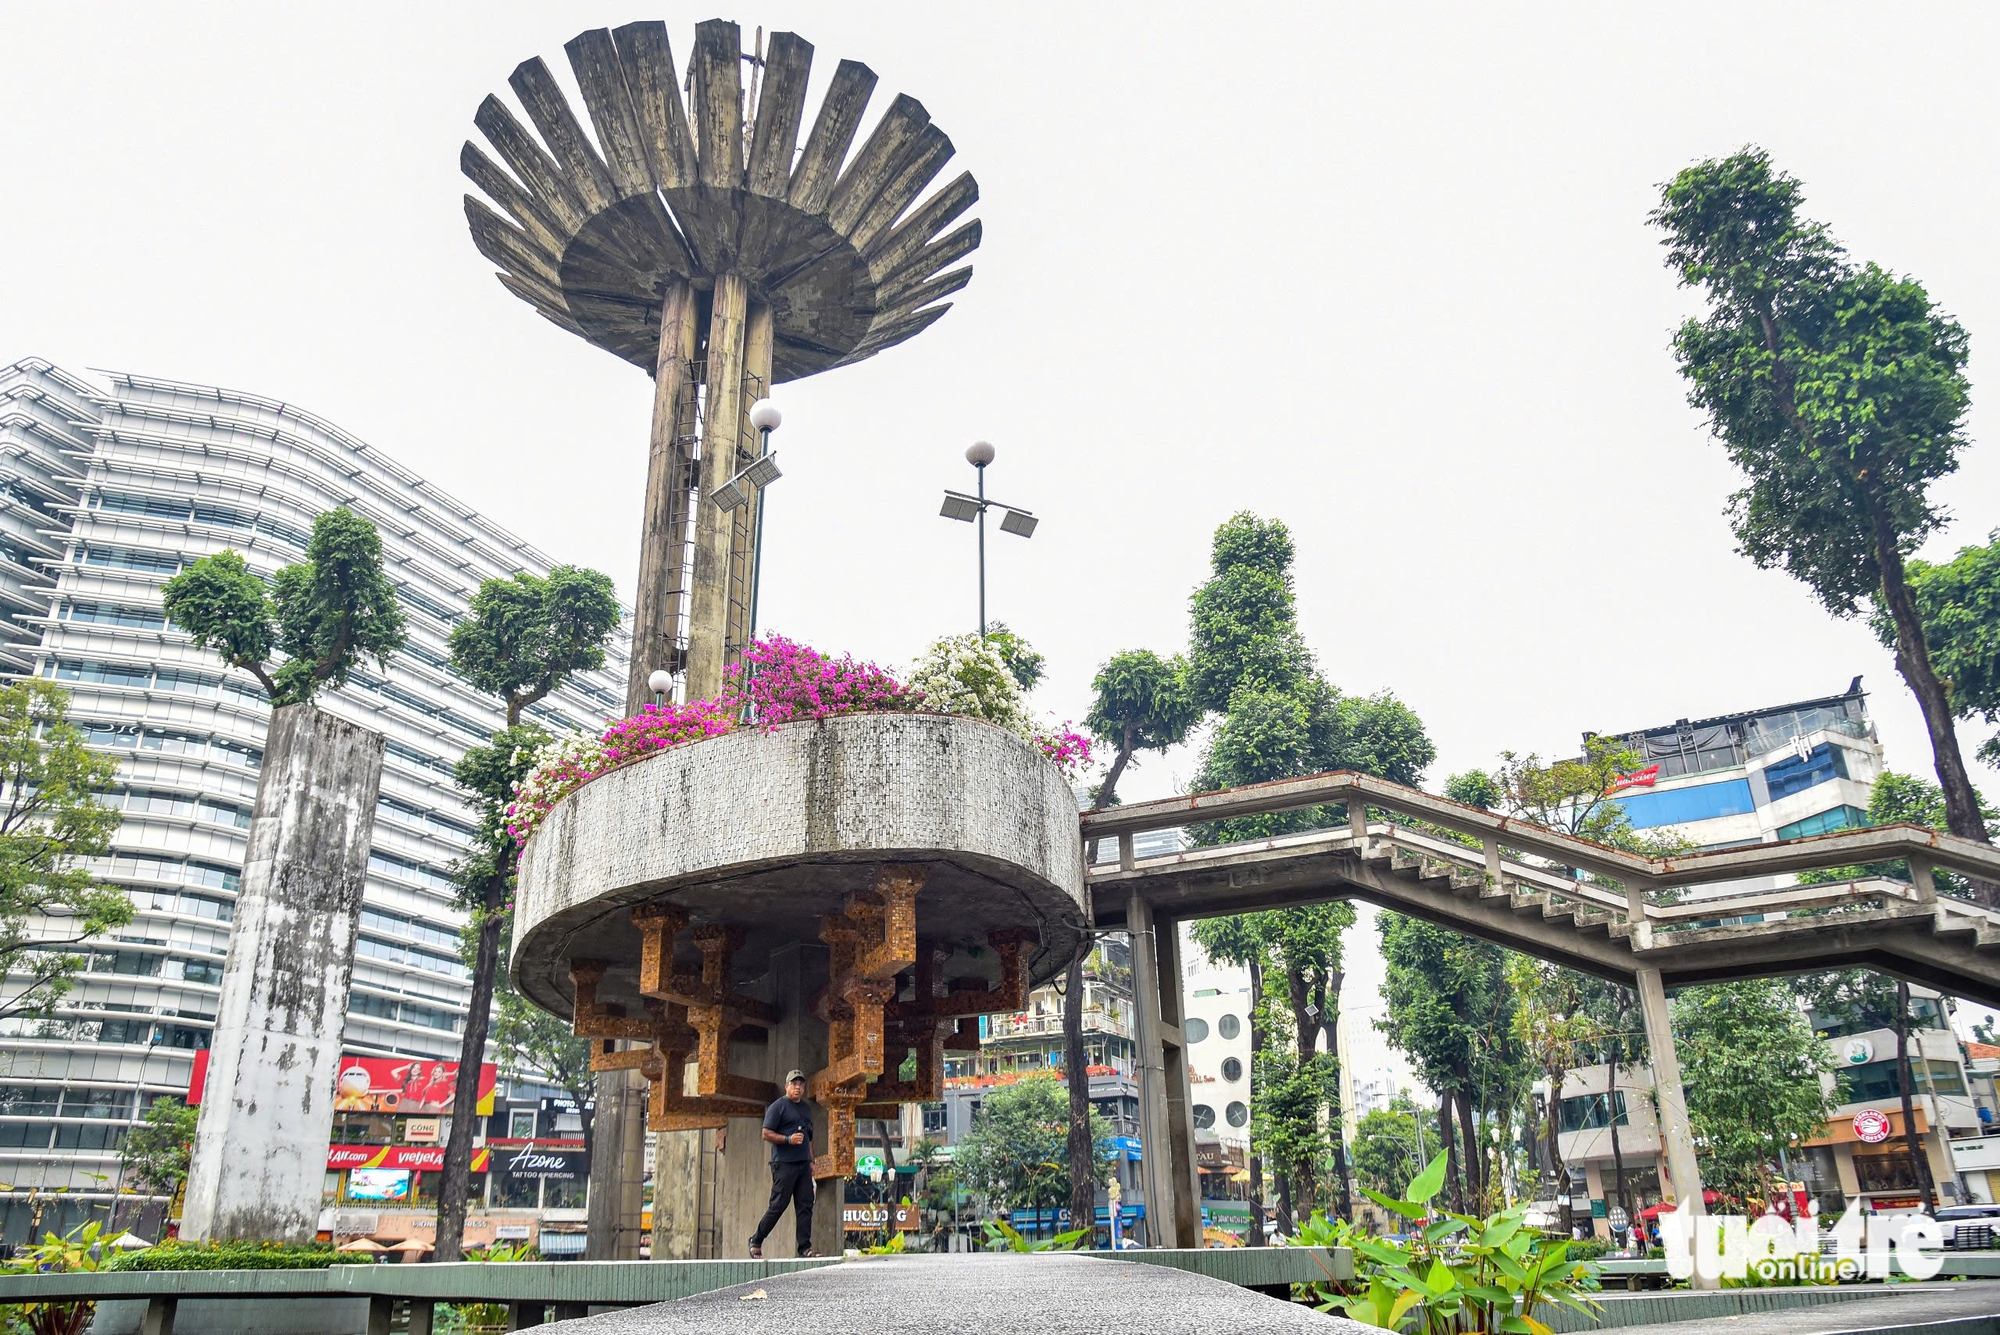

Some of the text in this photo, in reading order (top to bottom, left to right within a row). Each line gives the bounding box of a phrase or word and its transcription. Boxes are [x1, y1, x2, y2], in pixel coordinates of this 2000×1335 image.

[1854, 1110, 1886, 1126] HIGHLANDS
[1861, 1131, 1885, 1142] COFFEE
[508, 1141, 566, 1171] Azone
[512, 1171, 538, 1179] TATTOO
[544, 1171, 575, 1180] PIERCING
[843, 1209, 907, 1222] HUC LOG
